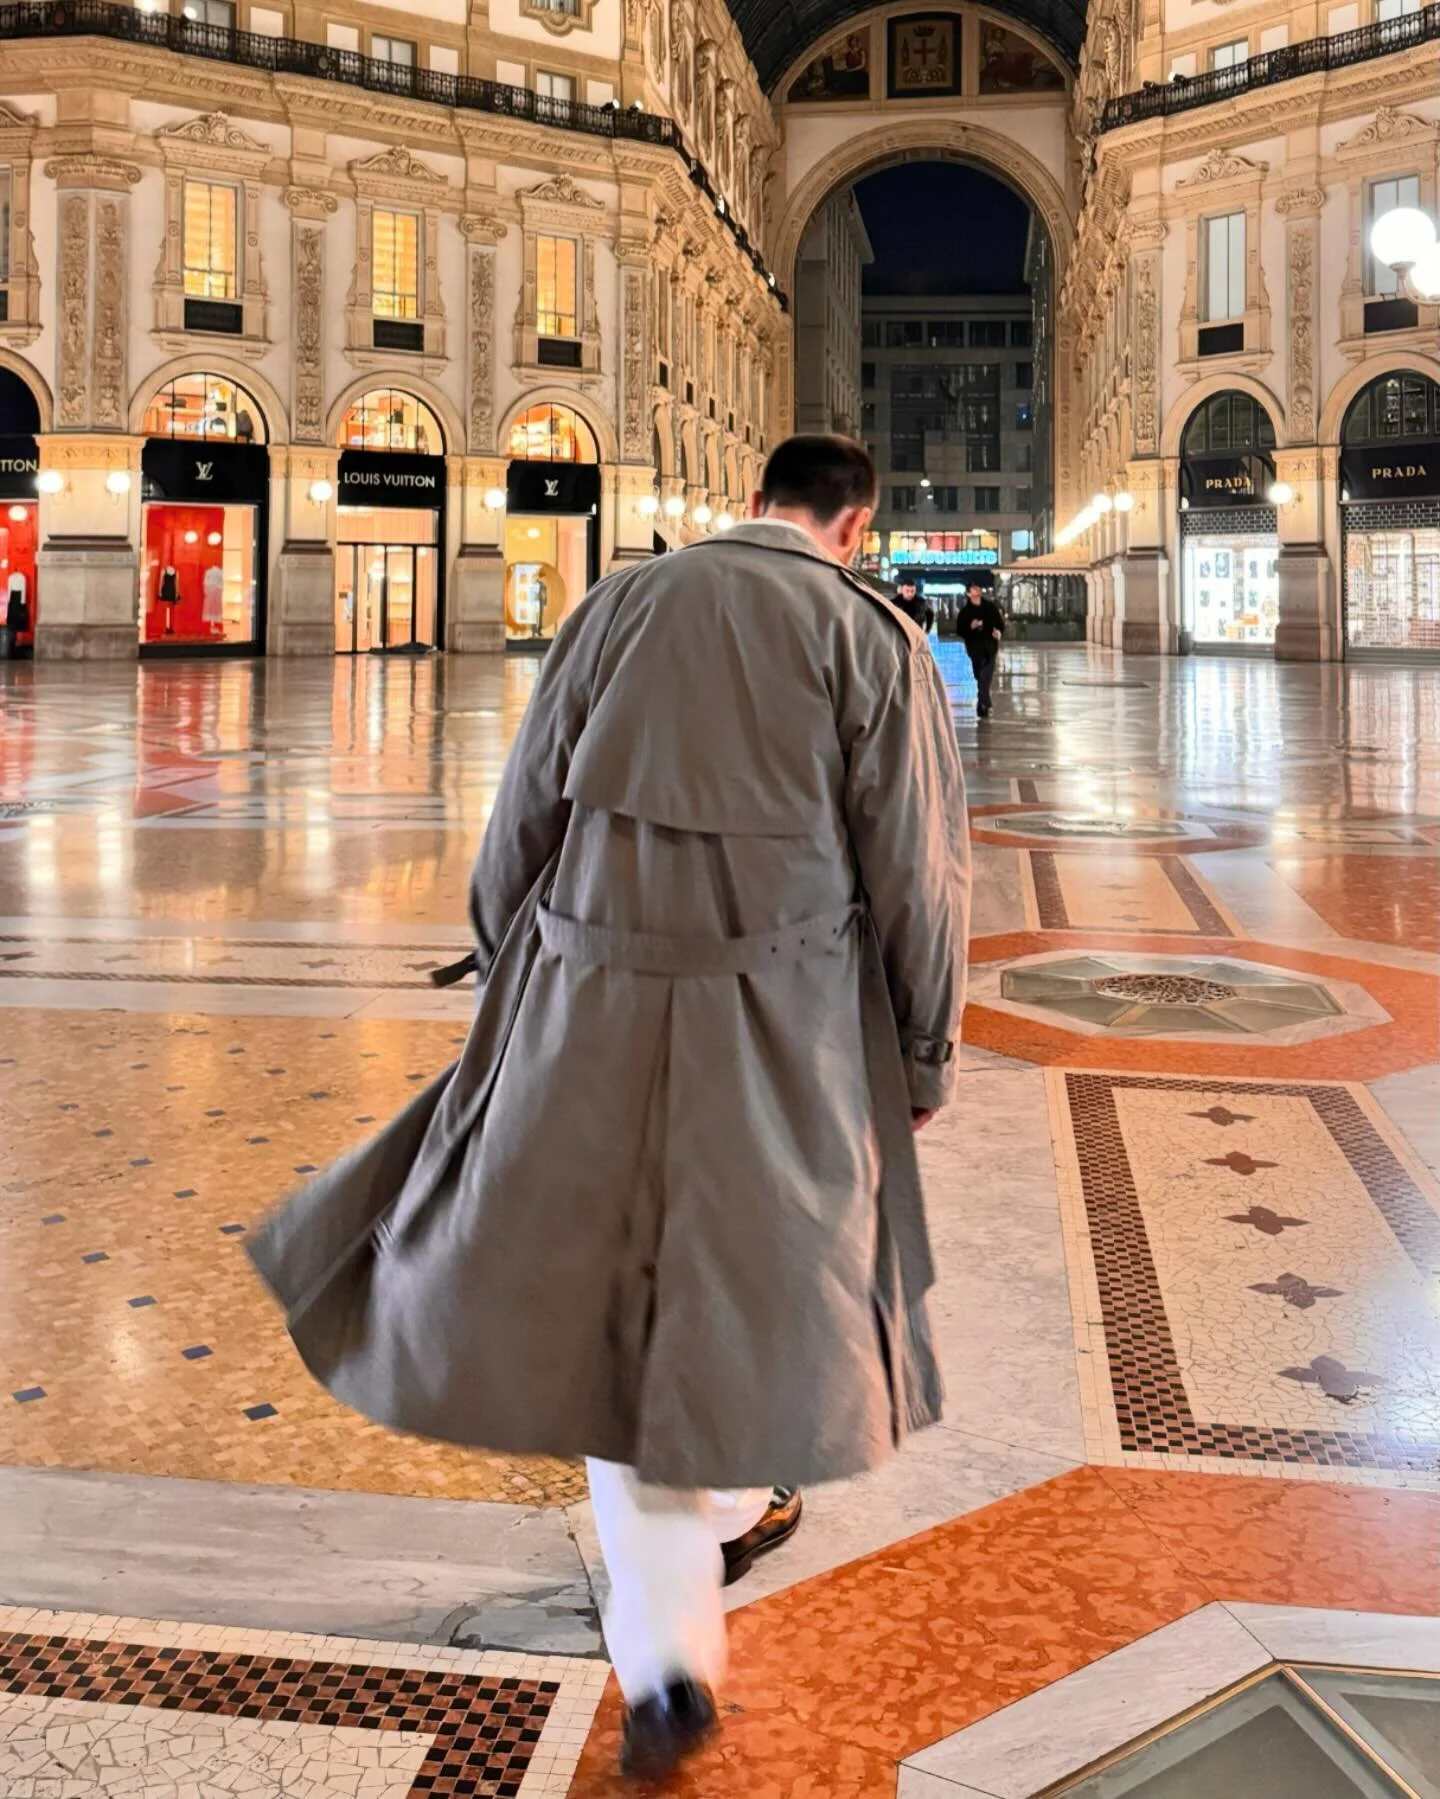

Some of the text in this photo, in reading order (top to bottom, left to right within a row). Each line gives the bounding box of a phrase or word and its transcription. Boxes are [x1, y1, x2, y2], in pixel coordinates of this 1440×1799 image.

[1372, 465, 1426, 479] PRADA
[344, 472, 435, 488] LOUIS VUITTON
[1206, 476, 1251, 489] PRADA
